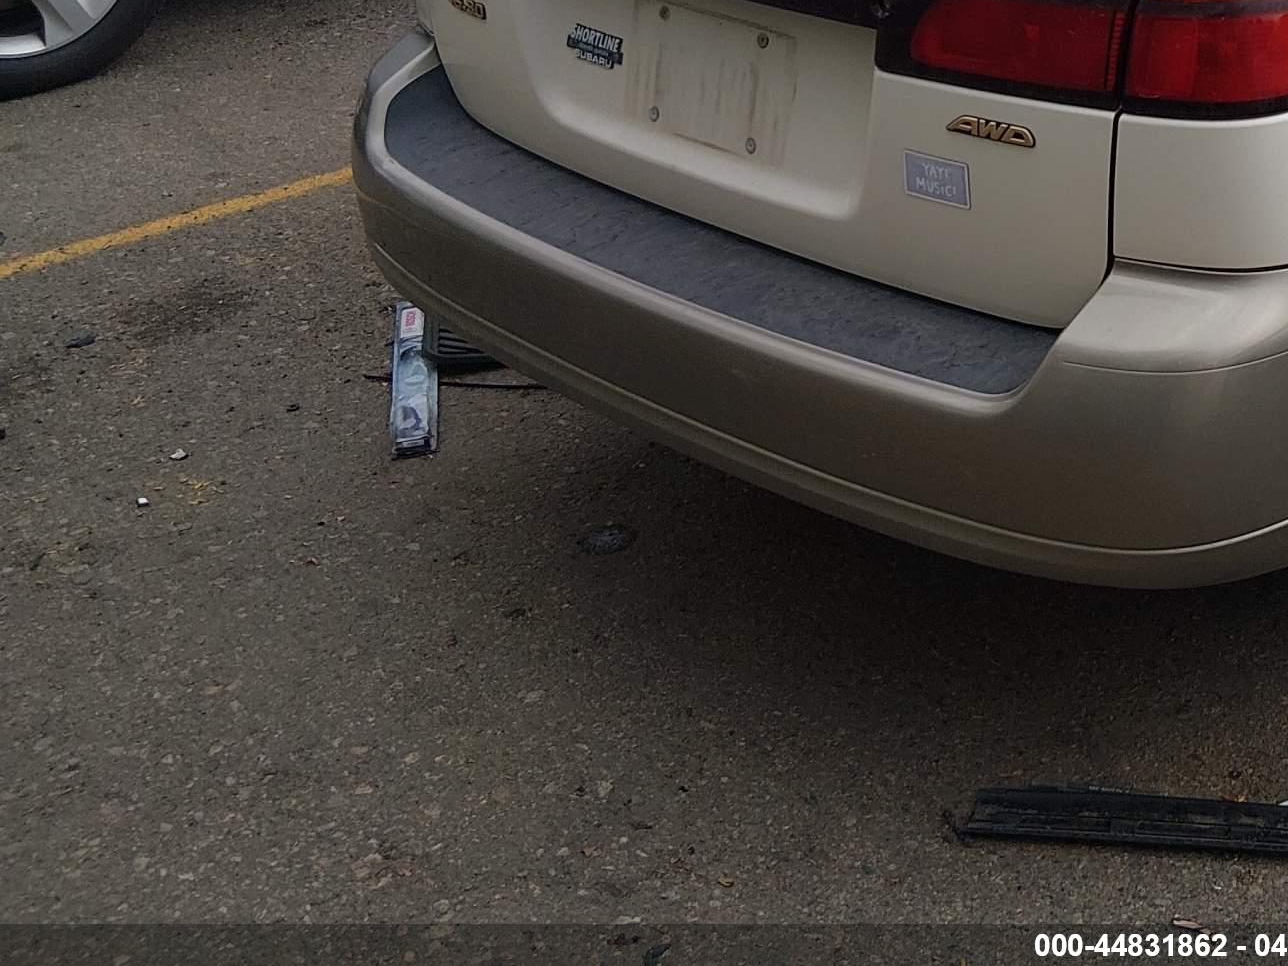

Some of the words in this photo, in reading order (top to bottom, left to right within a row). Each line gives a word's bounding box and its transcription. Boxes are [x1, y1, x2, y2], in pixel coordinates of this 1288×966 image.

[570, 24, 621, 52] SHORTLINE
[575, 48, 613, 68] SUBARU
[945, 114, 1036, 148] AWD
